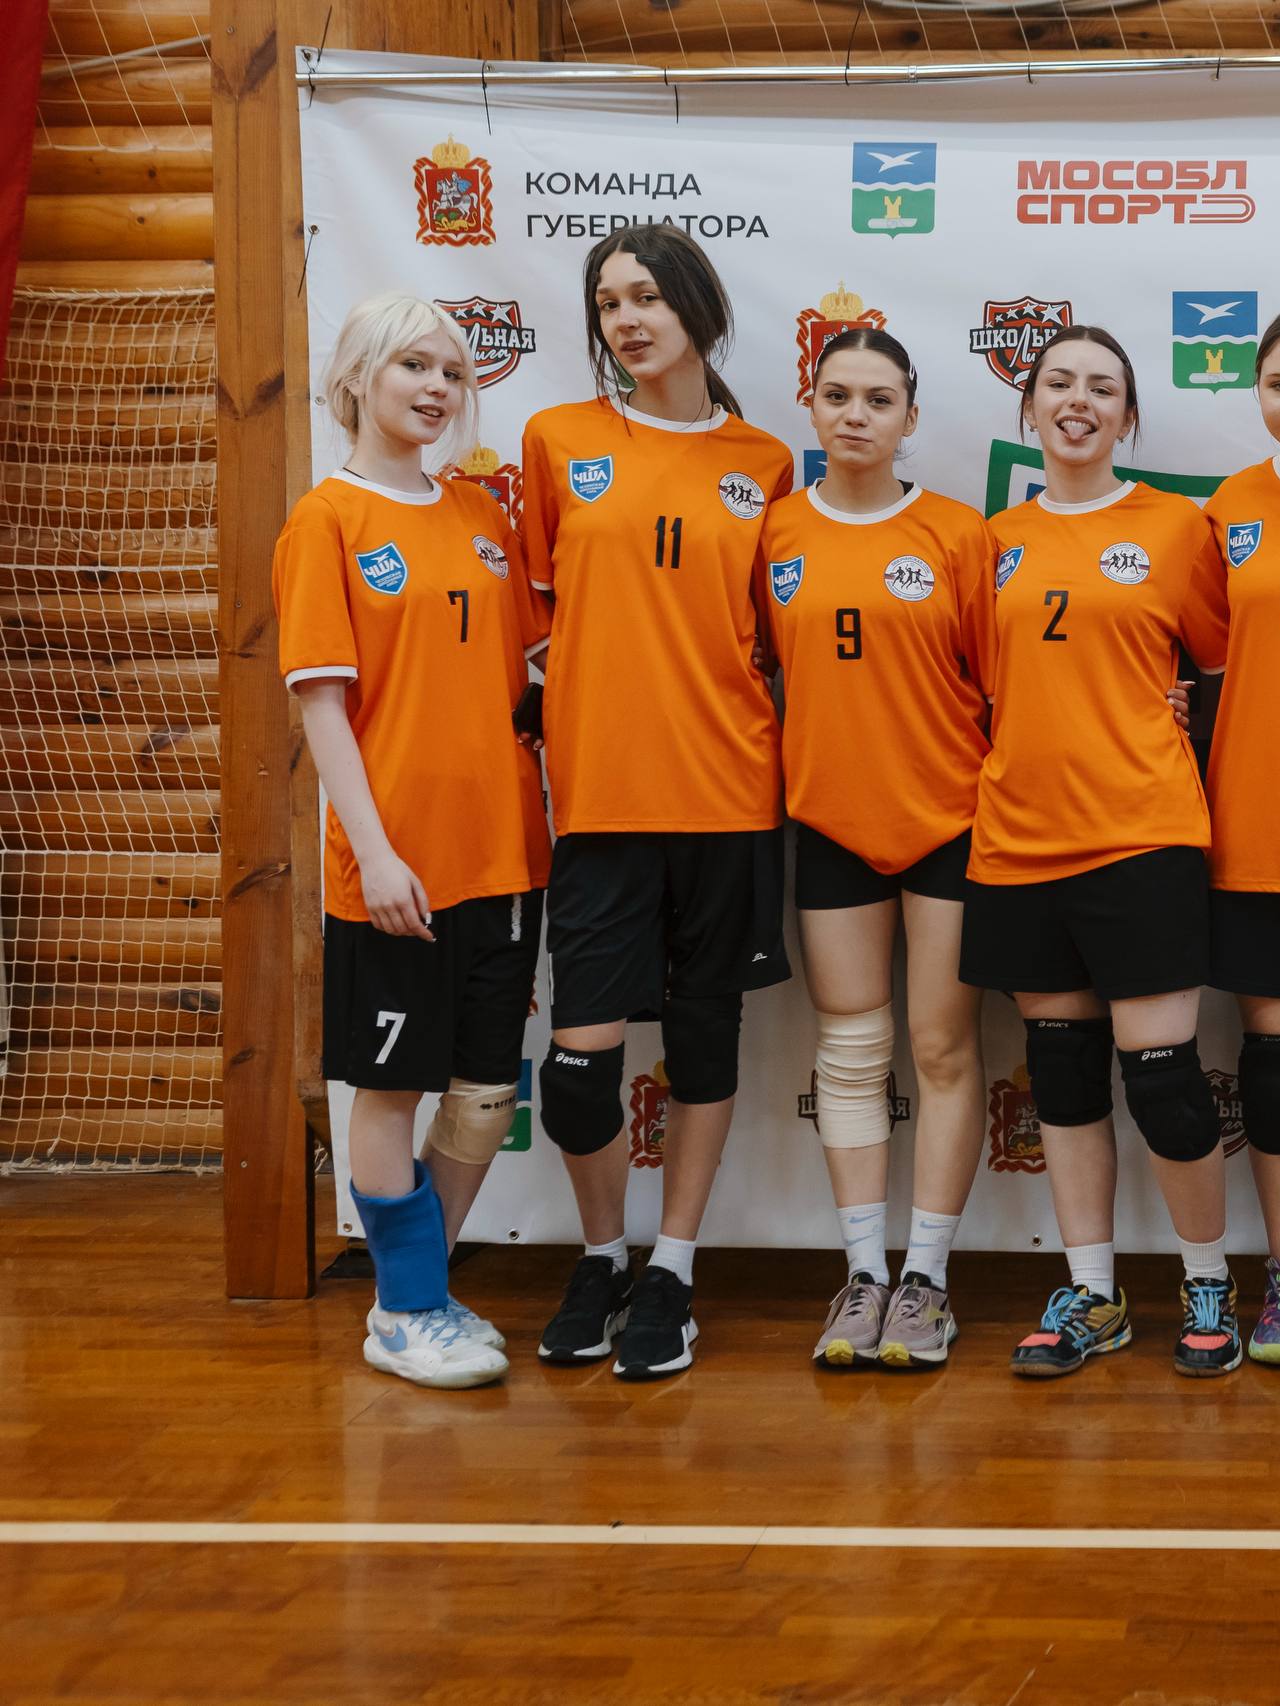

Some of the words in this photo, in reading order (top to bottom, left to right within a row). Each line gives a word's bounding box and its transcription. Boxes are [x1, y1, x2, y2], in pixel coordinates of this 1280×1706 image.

[525, 172, 702, 200] КОМАНДА
[1016, 160, 1248, 190] МОСОБЛ
[1016, 193, 1198, 224] СПОРТ
[573, 469, 608, 484] ЧШЛ
[655, 515, 682, 569] 11
[1230, 534, 1255, 548] ЧШЛ
[364, 558, 402, 578] ЧШЛ
[774, 571, 799, 587] ЧШЛ
[447, 589, 469, 643] 7
[1042, 590, 1069, 641] 2
[835, 608, 862, 660] 9
[374, 1010, 407, 1064] 7
